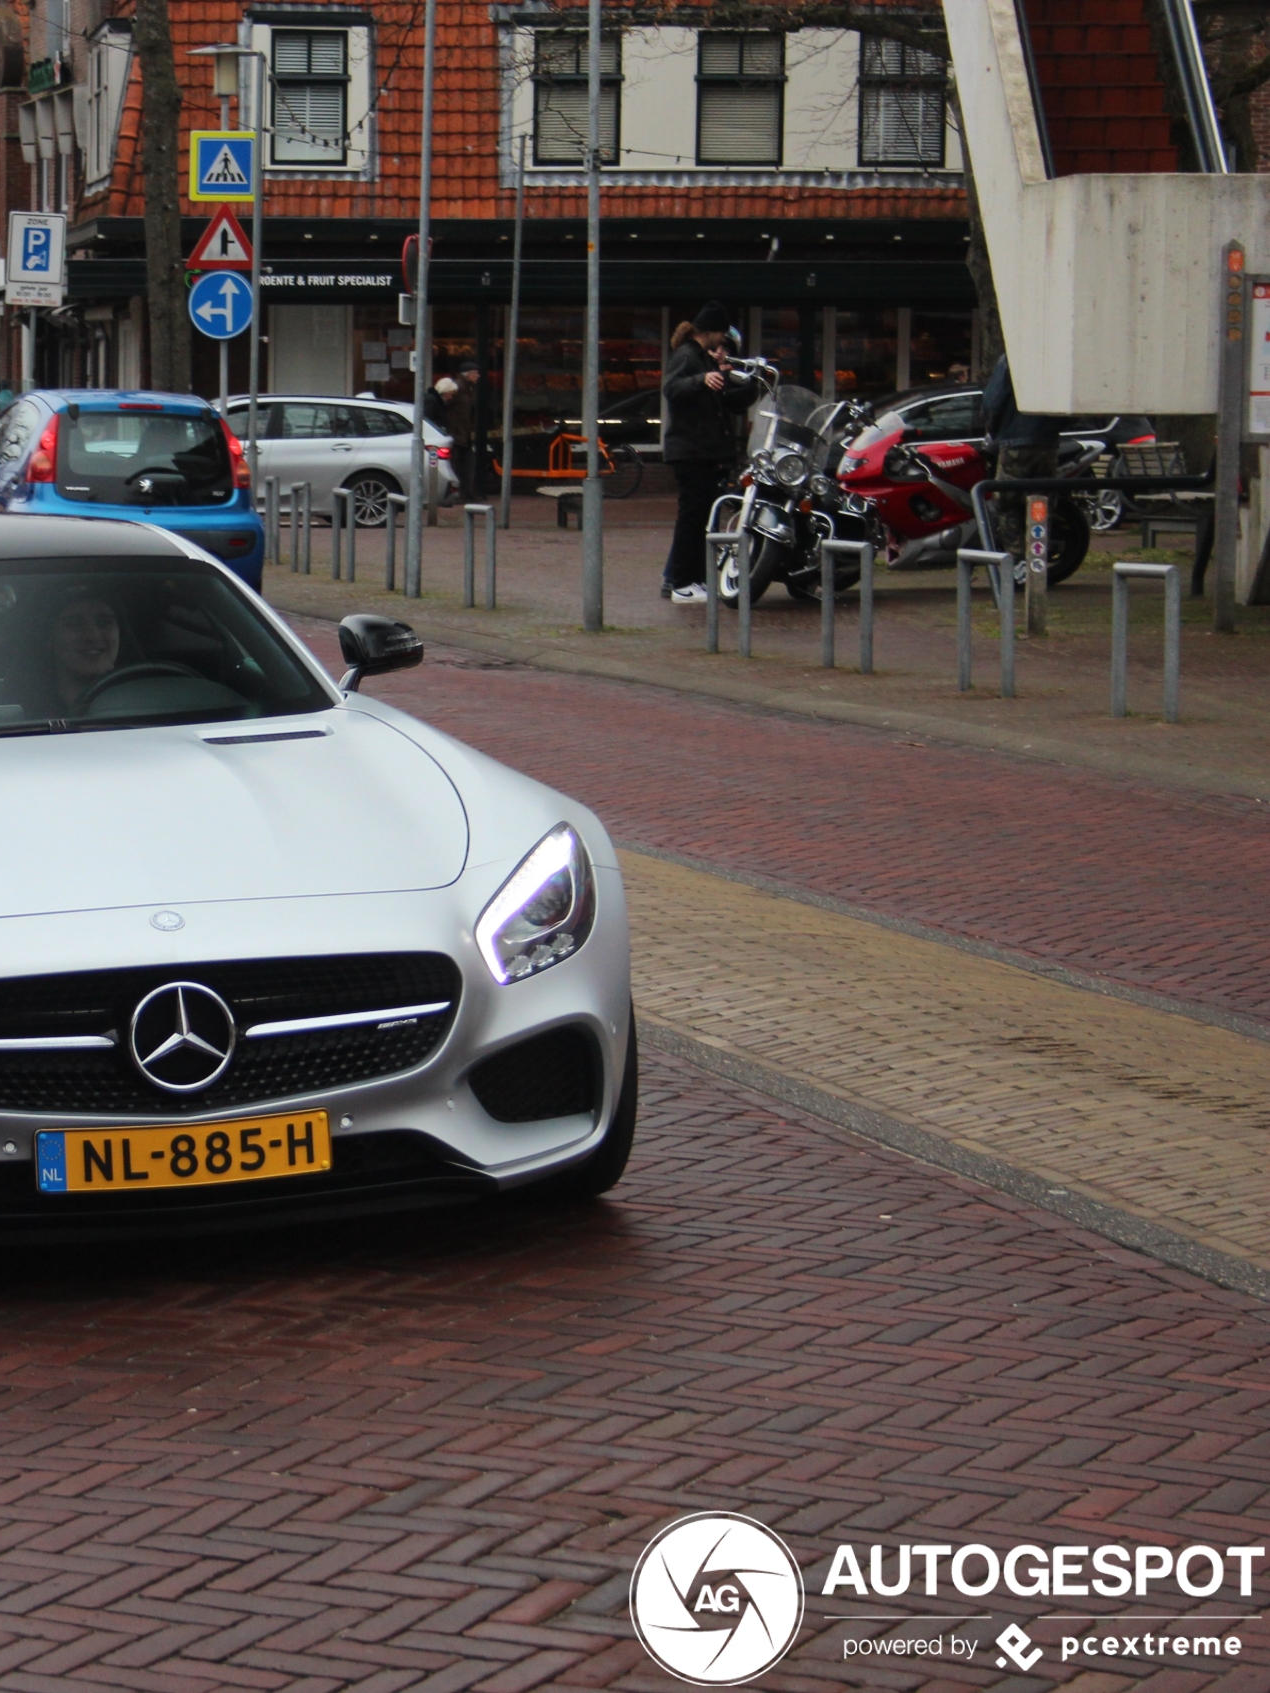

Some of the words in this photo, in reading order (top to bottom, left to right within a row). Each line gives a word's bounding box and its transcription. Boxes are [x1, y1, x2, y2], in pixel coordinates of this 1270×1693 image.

[27, 218, 49, 226] ZONE
[28, 230, 46, 254] P
[297, 275, 306, 286] &
[308, 275, 336, 286] FRUIT
[337, 275, 392, 286] SPECIALIST
[42, 1169, 62, 1181] NL
[82, 1121, 315, 1182] NL-885-H
